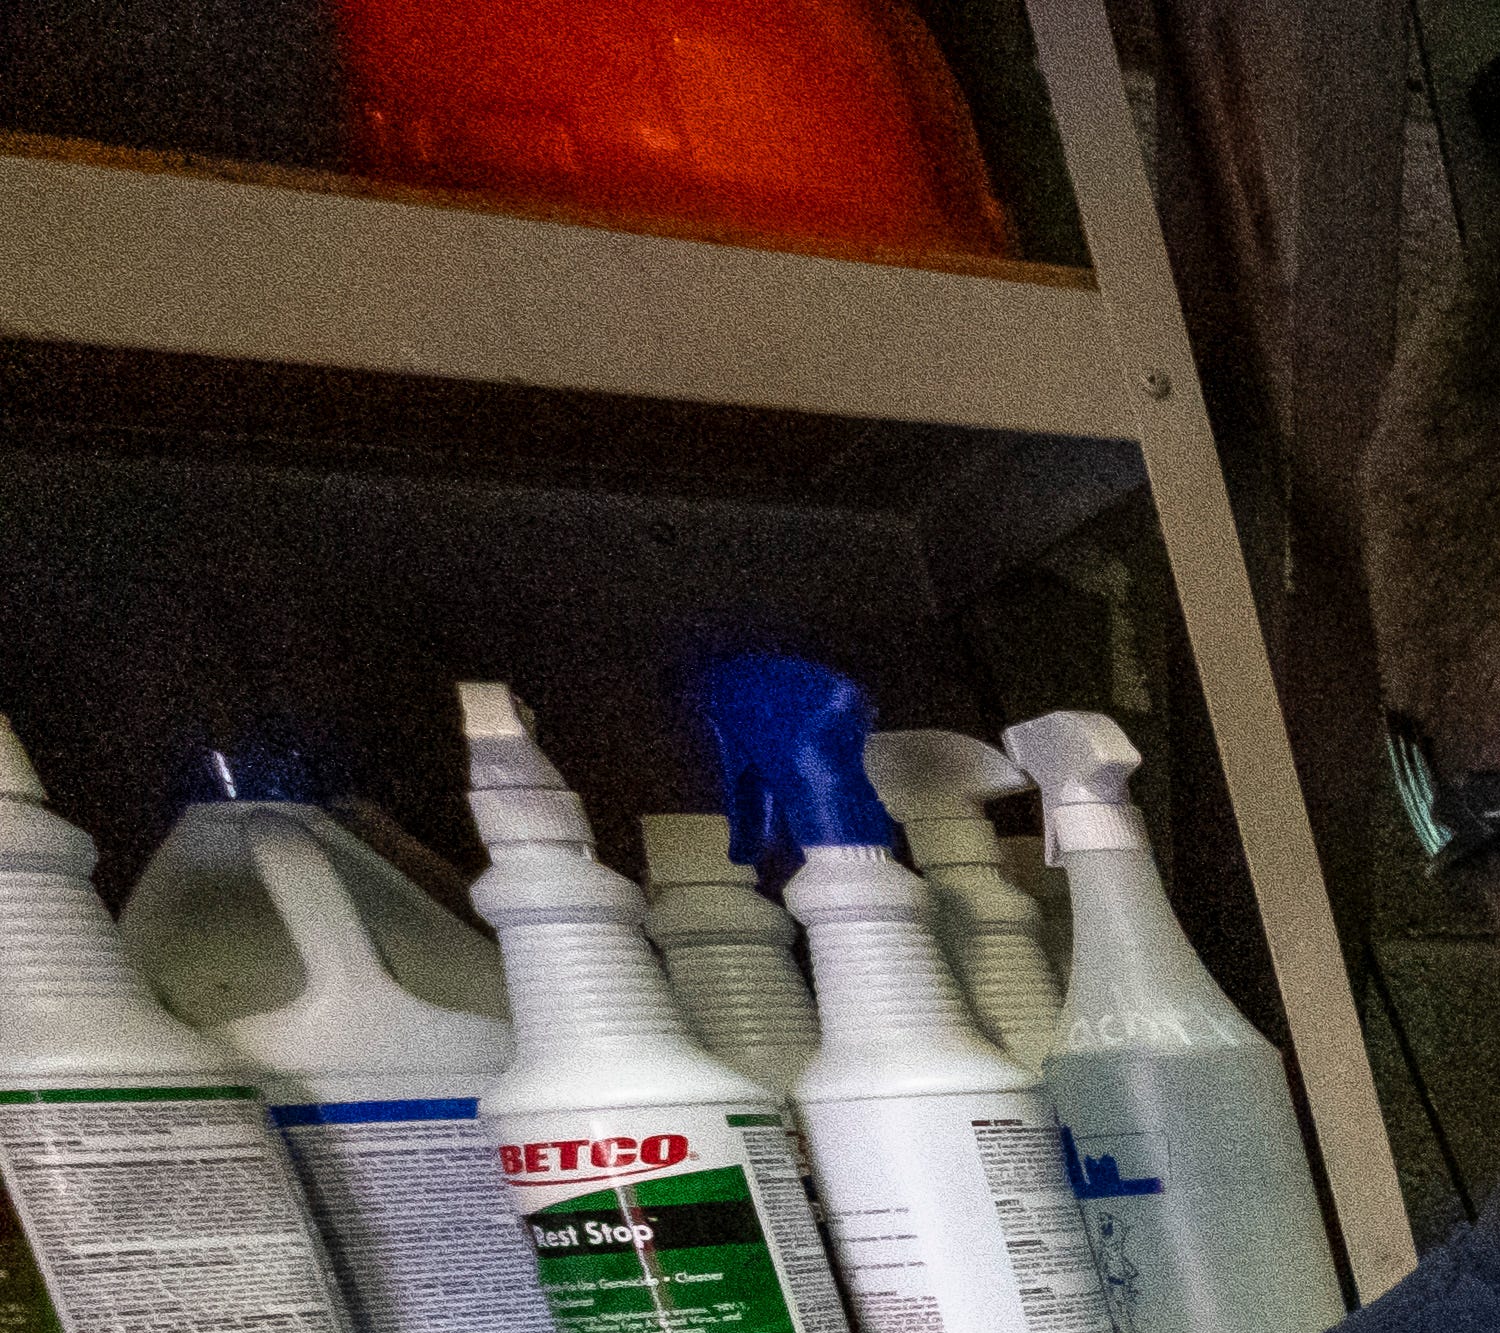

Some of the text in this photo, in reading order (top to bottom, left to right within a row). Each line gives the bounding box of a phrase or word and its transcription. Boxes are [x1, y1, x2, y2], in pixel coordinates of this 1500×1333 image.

[500, 1134, 688, 1175] BETCO
[533, 1221, 653, 1250] Rest Stop
